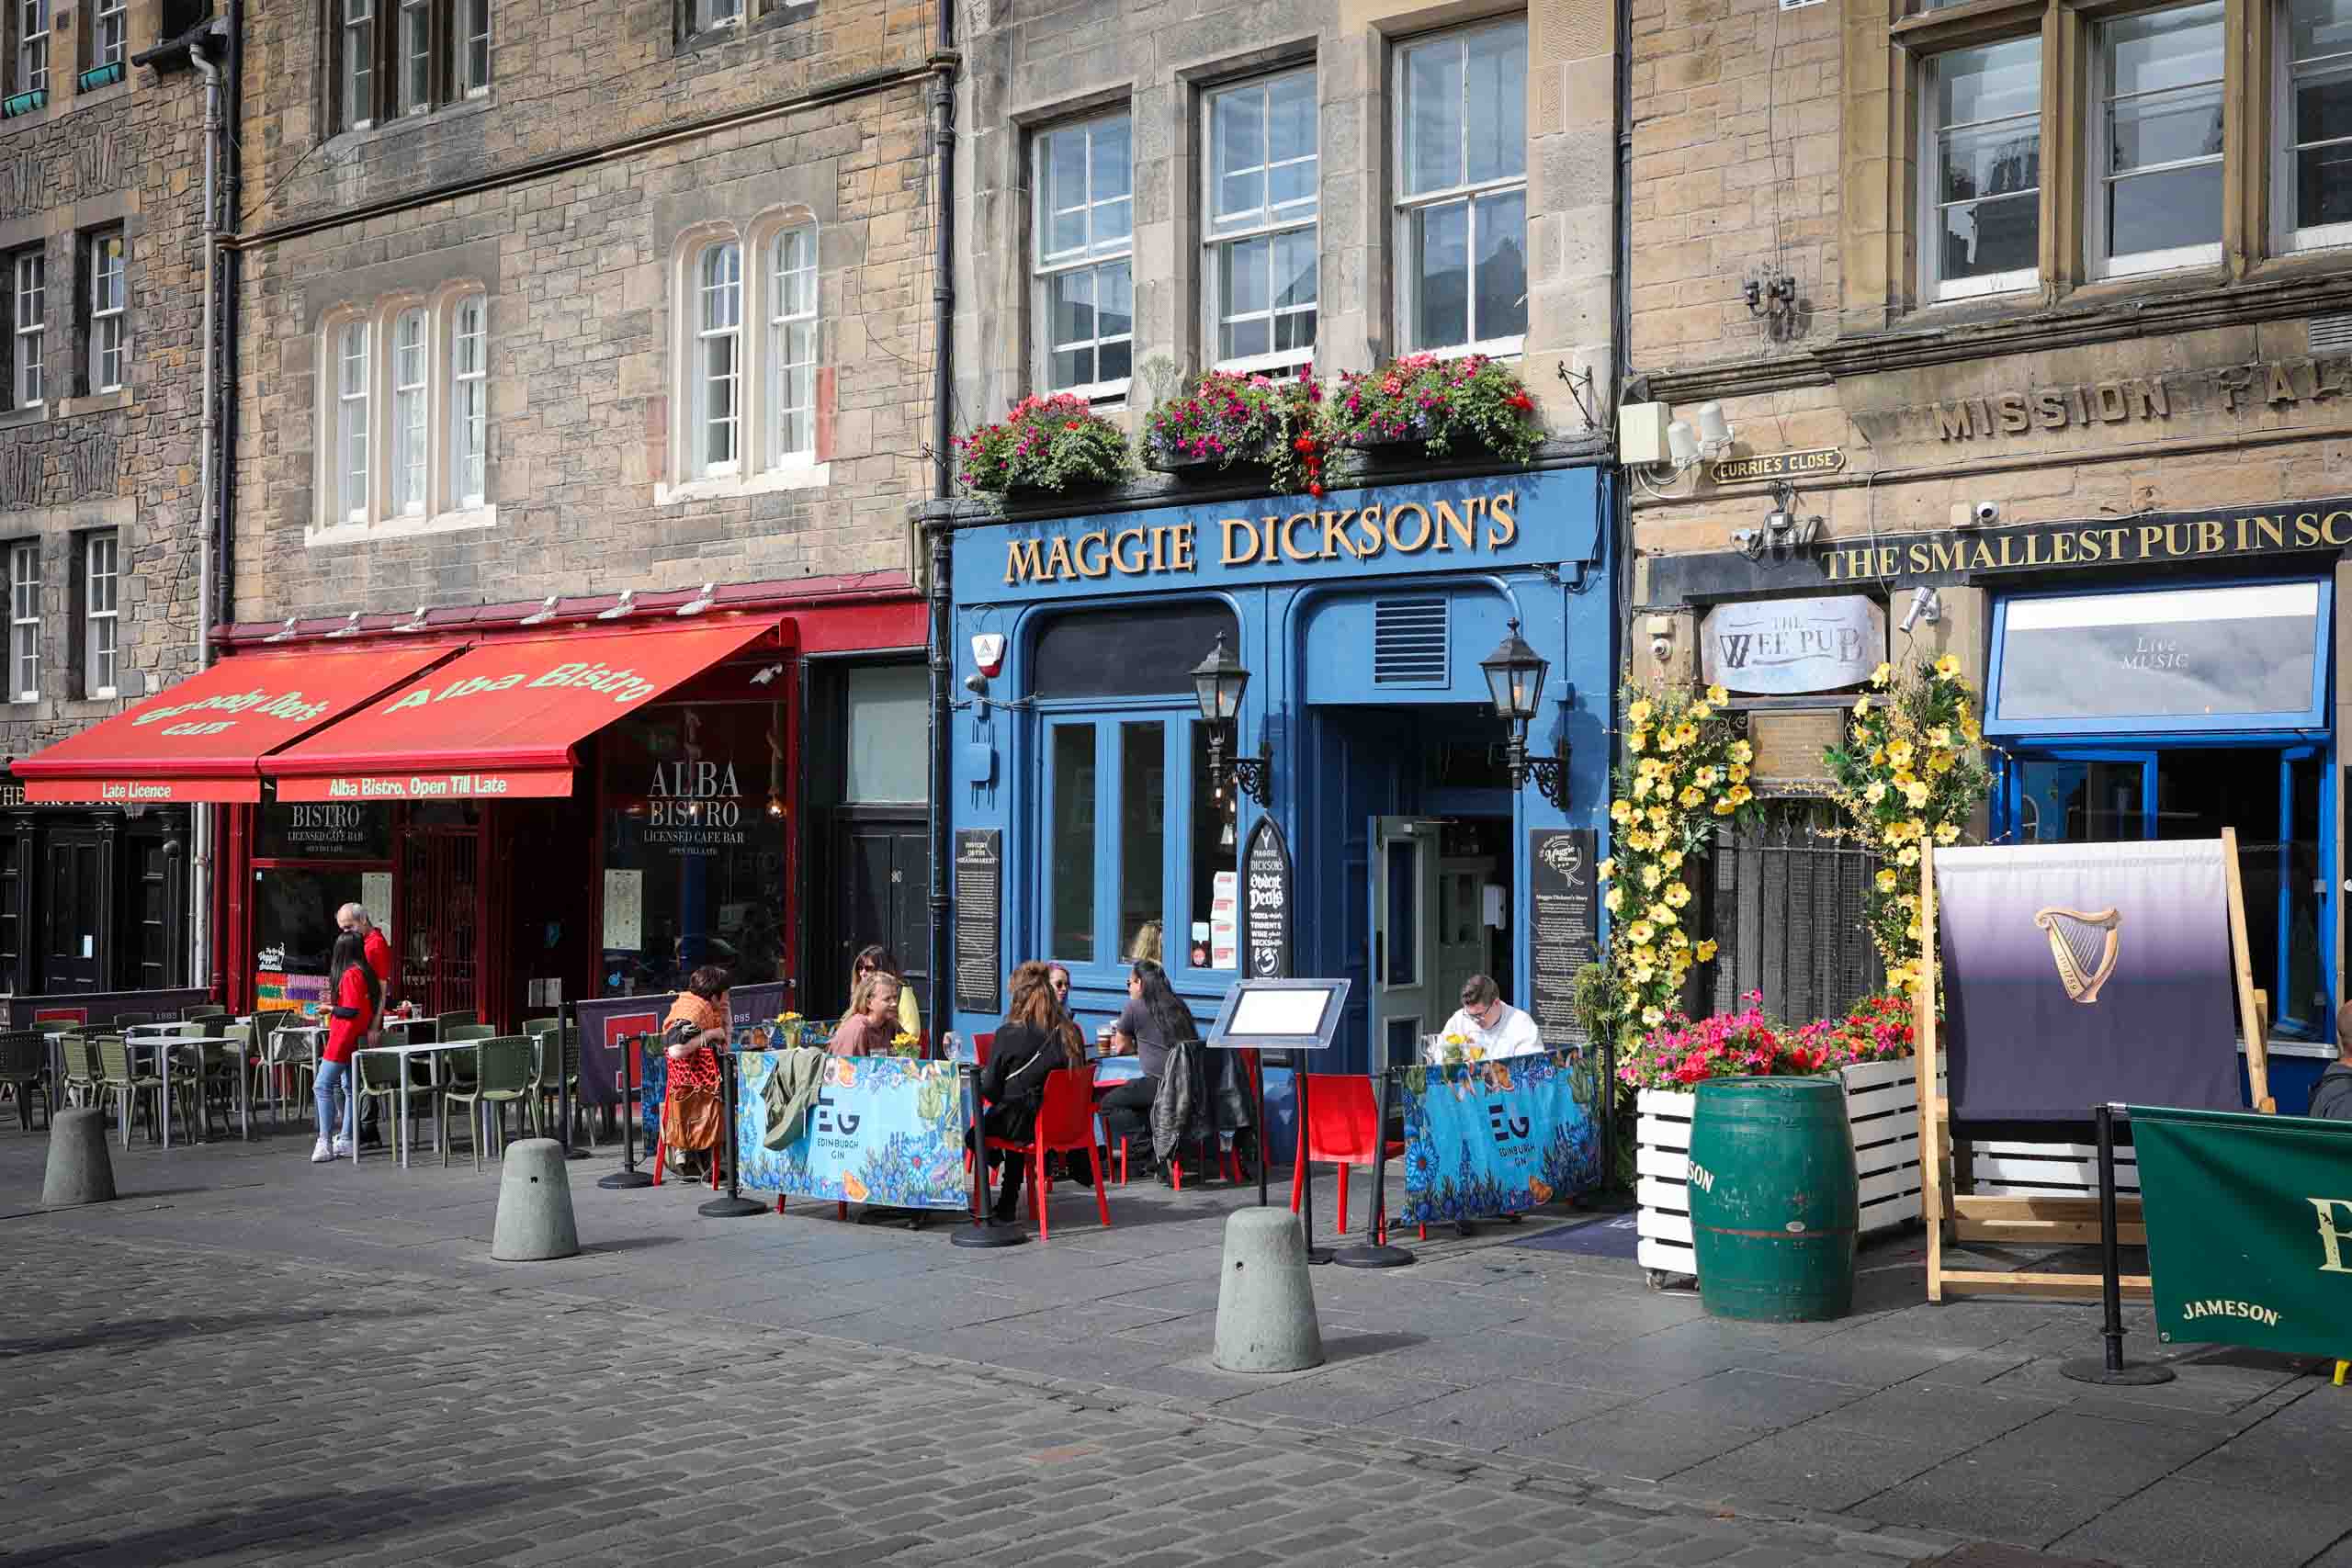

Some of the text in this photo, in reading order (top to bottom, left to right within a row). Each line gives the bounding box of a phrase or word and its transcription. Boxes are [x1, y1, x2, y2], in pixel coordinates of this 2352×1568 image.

[1930, 378, 2170, 441] MISSION
[1720, 453, 1834, 478] CURRIE'S CLOSE
[1003, 491, 1518, 585] MAGGIE DICKSON'S
[1821, 547, 1902, 581] THE
[1908, 527, 2130, 575] SMALLEST
[2137, 520, 2227, 559] PUB
[2233, 514, 2288, 552] IN
[1719, 627, 1864, 669] WEE PUB
[525, 661, 654, 704] Bistro
[102, 781, 172, 799] Late Licence
[329, 778, 358, 796] Alba
[410, 775, 447, 795] Open
[450, 774, 471, 794] Till
[474, 773, 507, 794] Late
[646, 760, 743, 797] ALBA
[0, 784, 25, 805] HE
[292, 805, 361, 828] BISTRO
[647, 800, 740, 827] BISTRO
[288, 830, 325, 842] LICENSED
[643, 830, 744, 844] LICENSED CAFE BAR
[1253, 849, 1278, 858] MAGGIE
[1250, 859, 1284, 872] DICKSON'S
[817, 1138, 859, 1149] EDINBURGH
[831, 1150, 845, 1160] GIN
[2183, 1300, 2278, 1326] JAMESON
